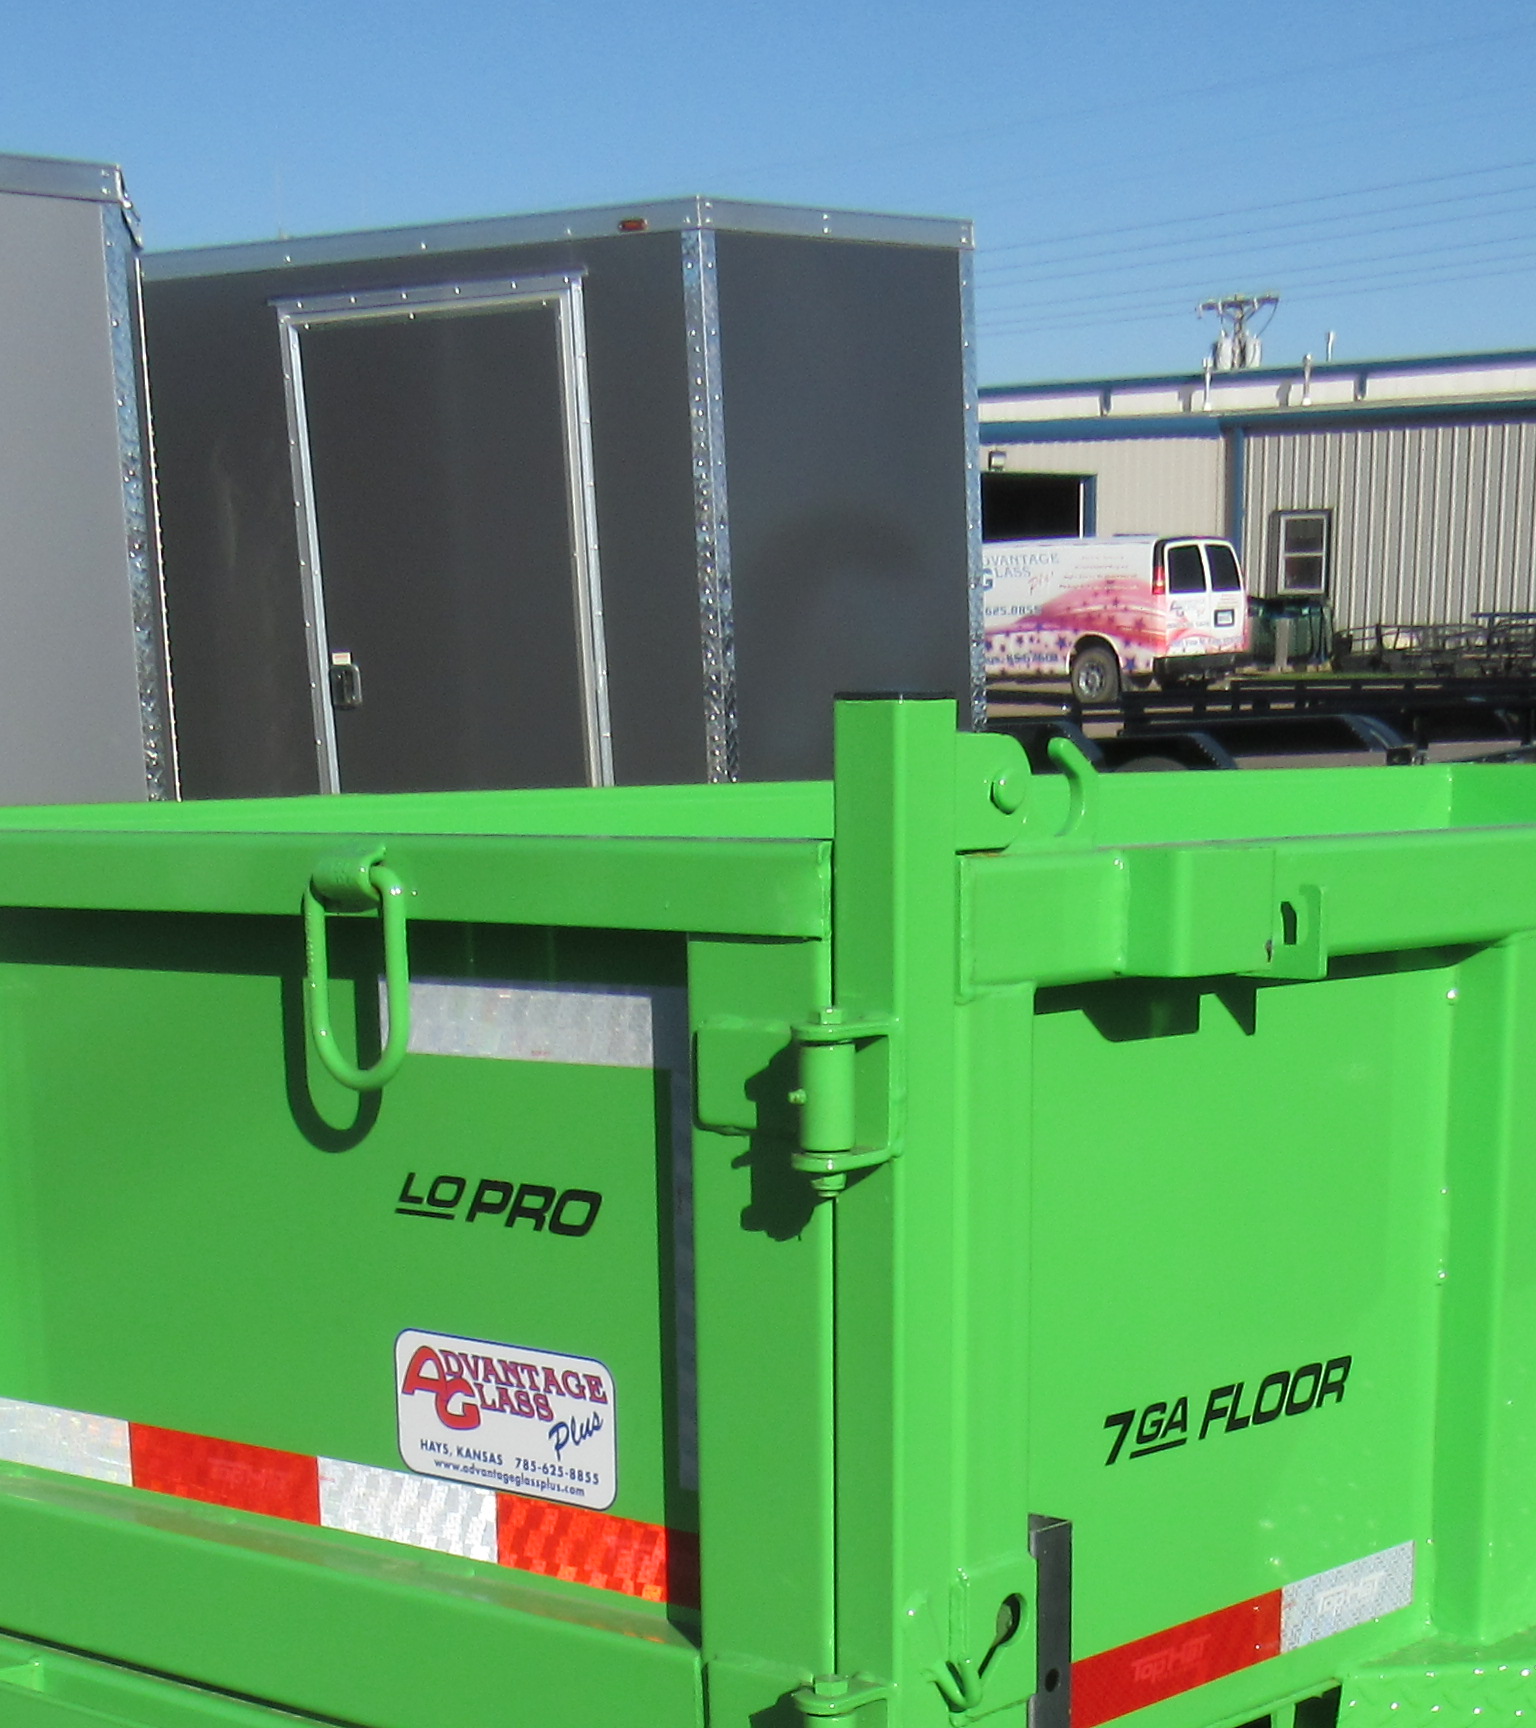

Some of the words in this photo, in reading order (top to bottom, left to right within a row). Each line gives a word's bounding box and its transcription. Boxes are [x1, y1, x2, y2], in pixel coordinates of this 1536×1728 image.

[466, 1178, 603, 1237] PRO
[402, 1345, 609, 1405] ADVANTAGE
[1198, 1355, 1353, 1440] FLOOR
[435, 1377, 555, 1431] GLASS
[419, 1438, 454, 1458] HAYS,
[456, 1445, 504, 1466] KANSAS
[514, 1457, 600, 1486] 785-625-8855
[548, 1411, 604, 1461] Plus
[433, 1457, 586, 1497] www.advantageglassplus.com
